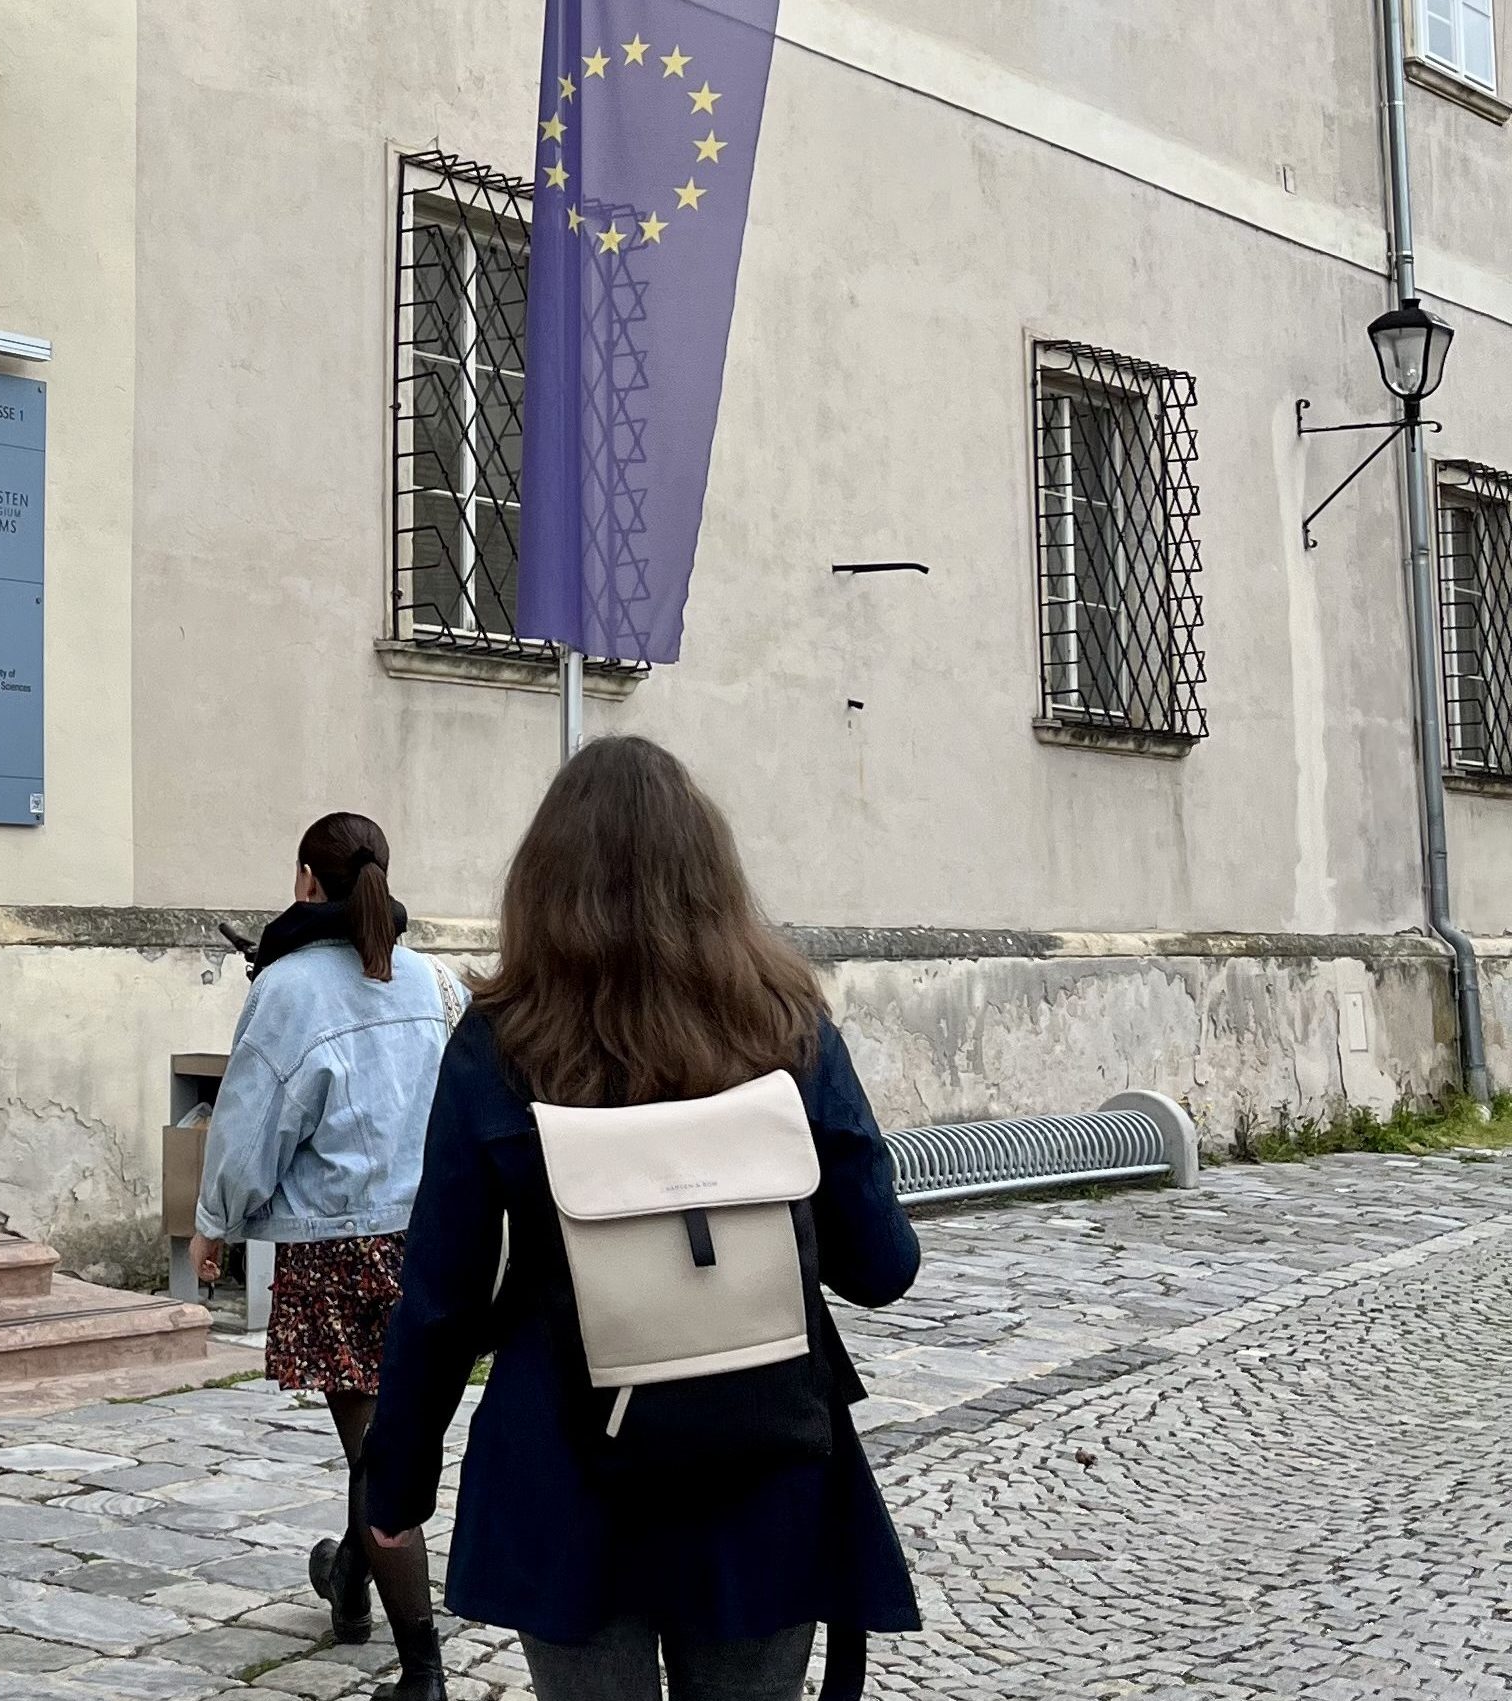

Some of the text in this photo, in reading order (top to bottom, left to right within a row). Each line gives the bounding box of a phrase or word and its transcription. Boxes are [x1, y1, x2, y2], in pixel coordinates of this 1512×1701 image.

[19, 410, 24, 421] 1
[8, 668, 16, 678] of
[0, 681, 32, 693] Sciences
